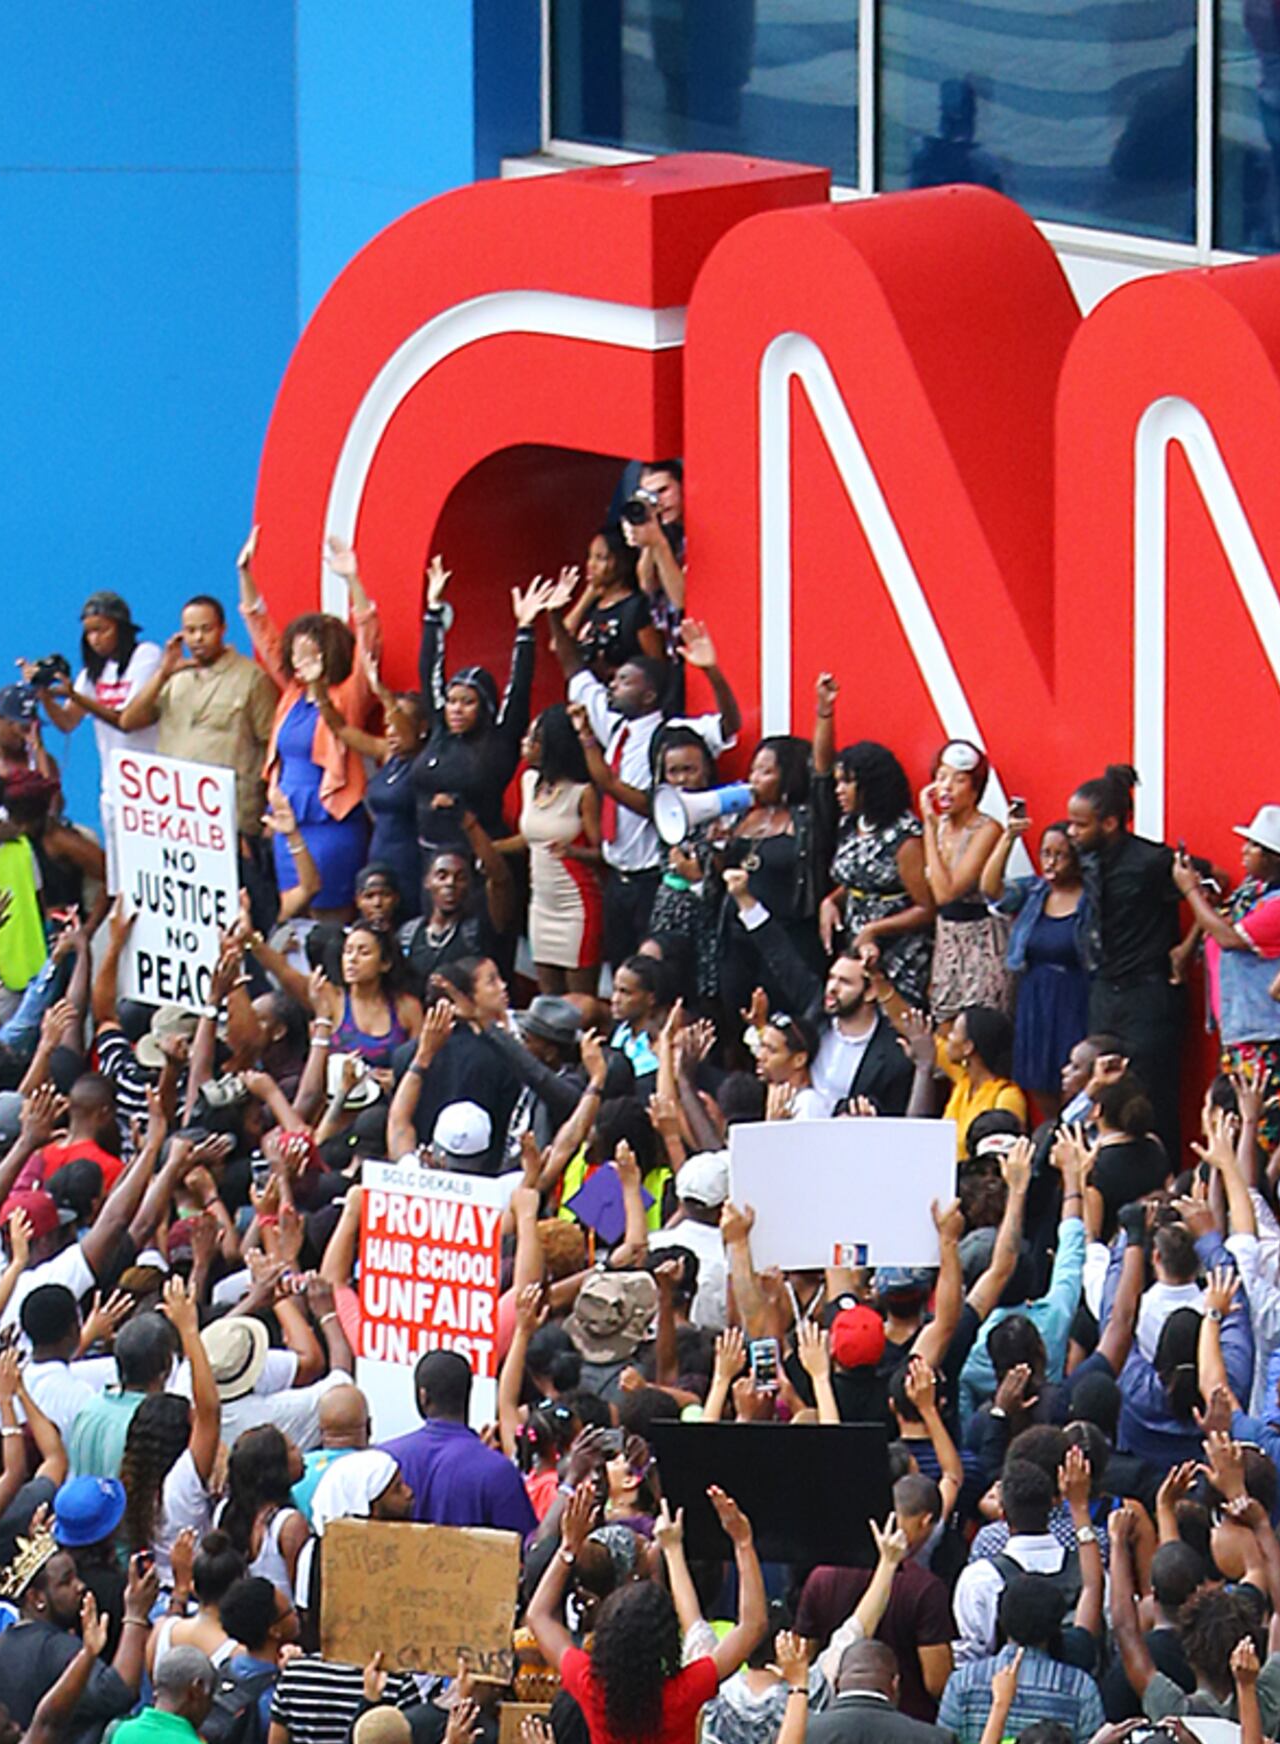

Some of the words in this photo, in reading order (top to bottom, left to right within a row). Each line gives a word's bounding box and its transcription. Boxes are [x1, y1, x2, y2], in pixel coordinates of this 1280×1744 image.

[118, 759, 221, 817] SCLC
[122, 805, 225, 851] DEKALB
[162, 848, 196, 873] NO
[132, 870, 227, 928] JUSTICE
[165, 926, 199, 952] NO
[136, 951, 213, 1008] PEAC
[381, 1168, 416, 1187] SCLC
[419, 1175, 472, 1196] DEKALB
[367, 1190, 501, 1248] PROWAY
[365, 1238, 413, 1275] HAIR
[417, 1245, 495, 1287] SCHOOL
[364, 1274, 494, 1334] UNFAIR
